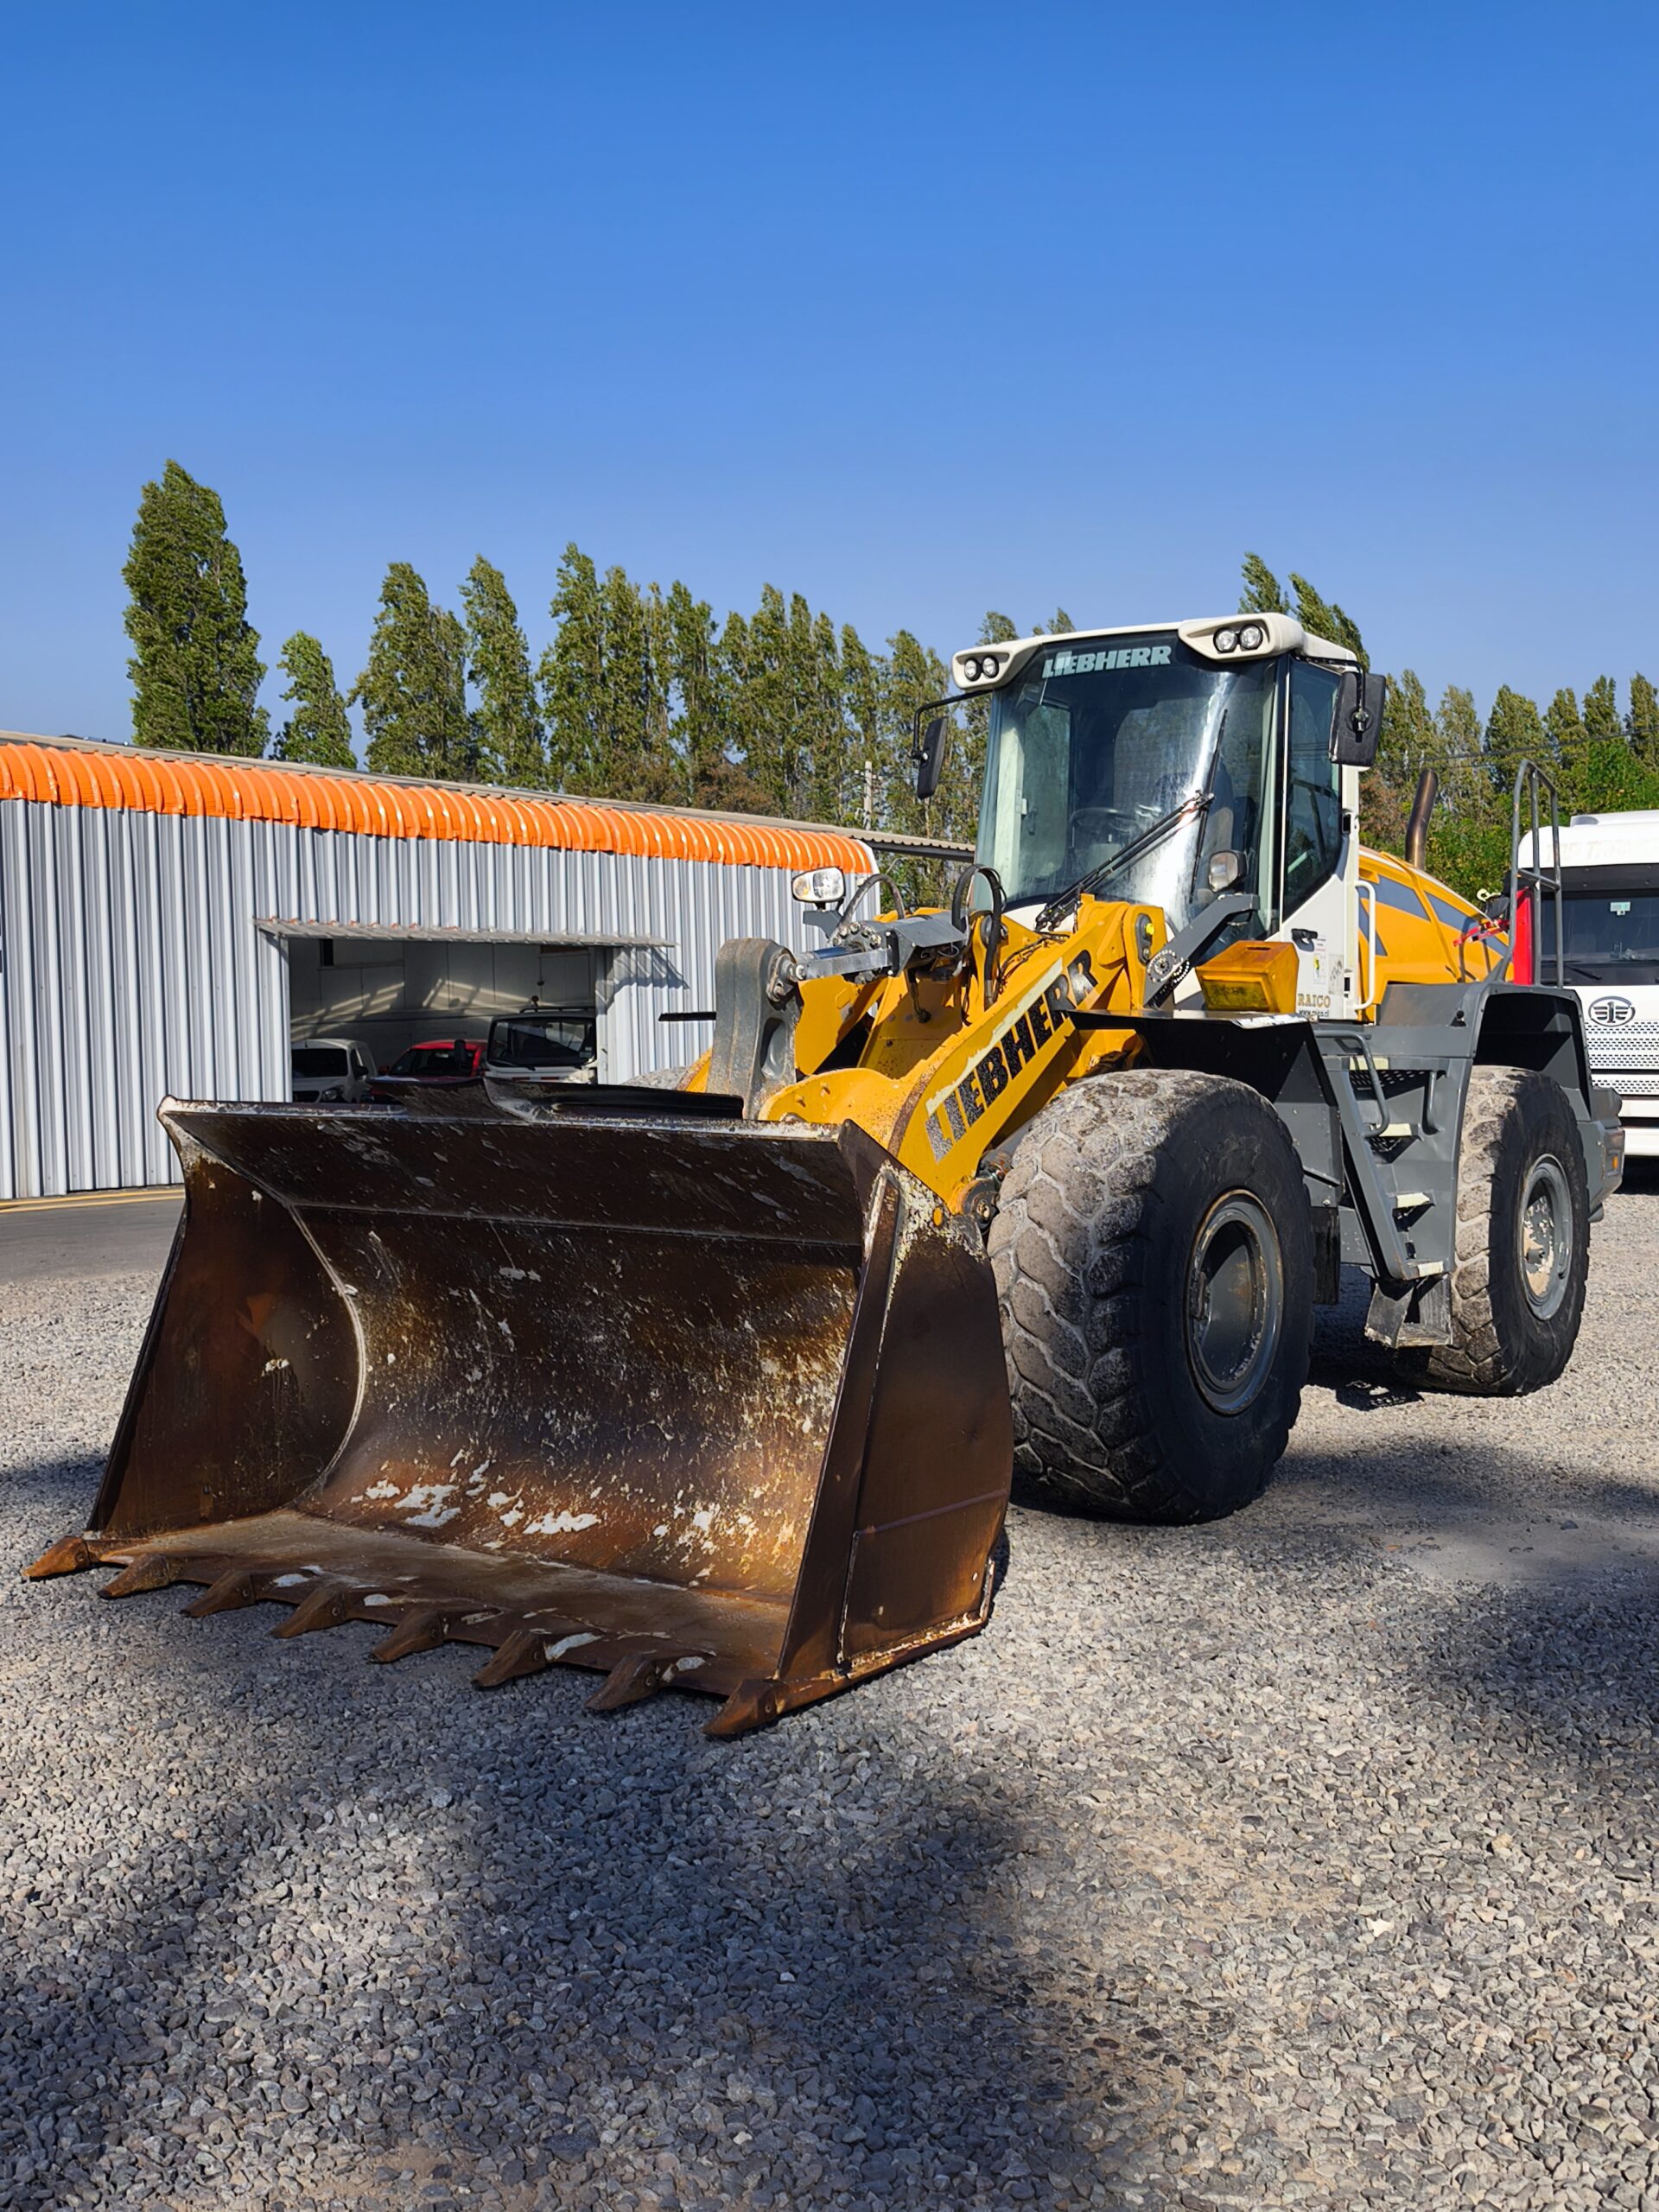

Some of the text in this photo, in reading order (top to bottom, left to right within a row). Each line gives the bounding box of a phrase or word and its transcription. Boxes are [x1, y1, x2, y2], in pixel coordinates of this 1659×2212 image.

[1042, 645, 1172, 678] LIEBHERR
[1298, 994, 1331, 1008] RAICO
[925, 950, 1098, 1163] LIEBHERR
